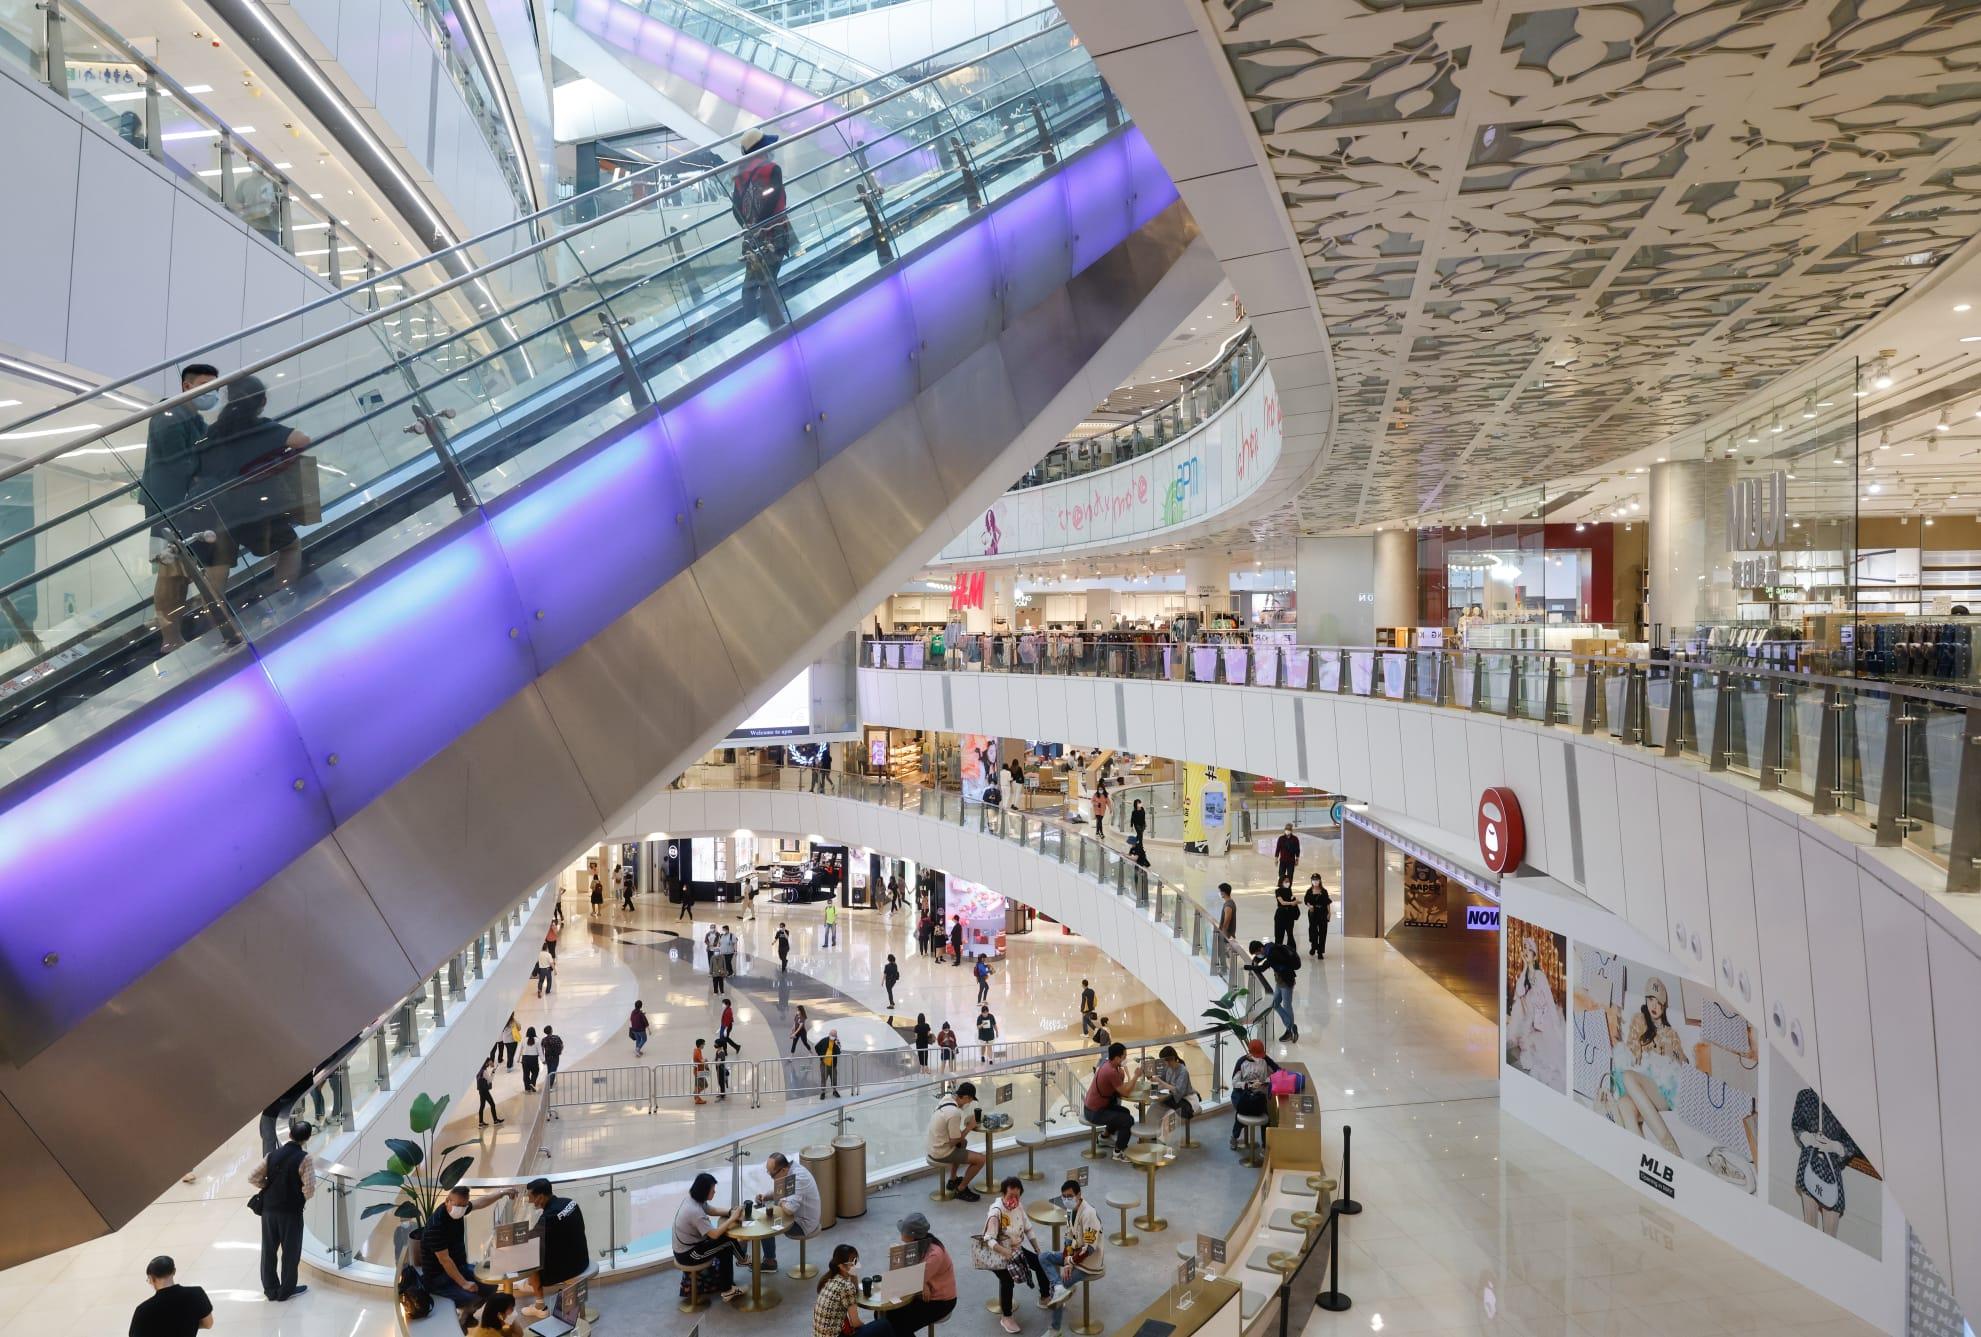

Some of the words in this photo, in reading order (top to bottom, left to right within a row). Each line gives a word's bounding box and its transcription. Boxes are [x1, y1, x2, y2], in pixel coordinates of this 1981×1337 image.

[1725, 470, 1785, 552] MUJI
[950, 571, 985, 610] H&M
[1640, 1153, 1674, 1182] MLB
